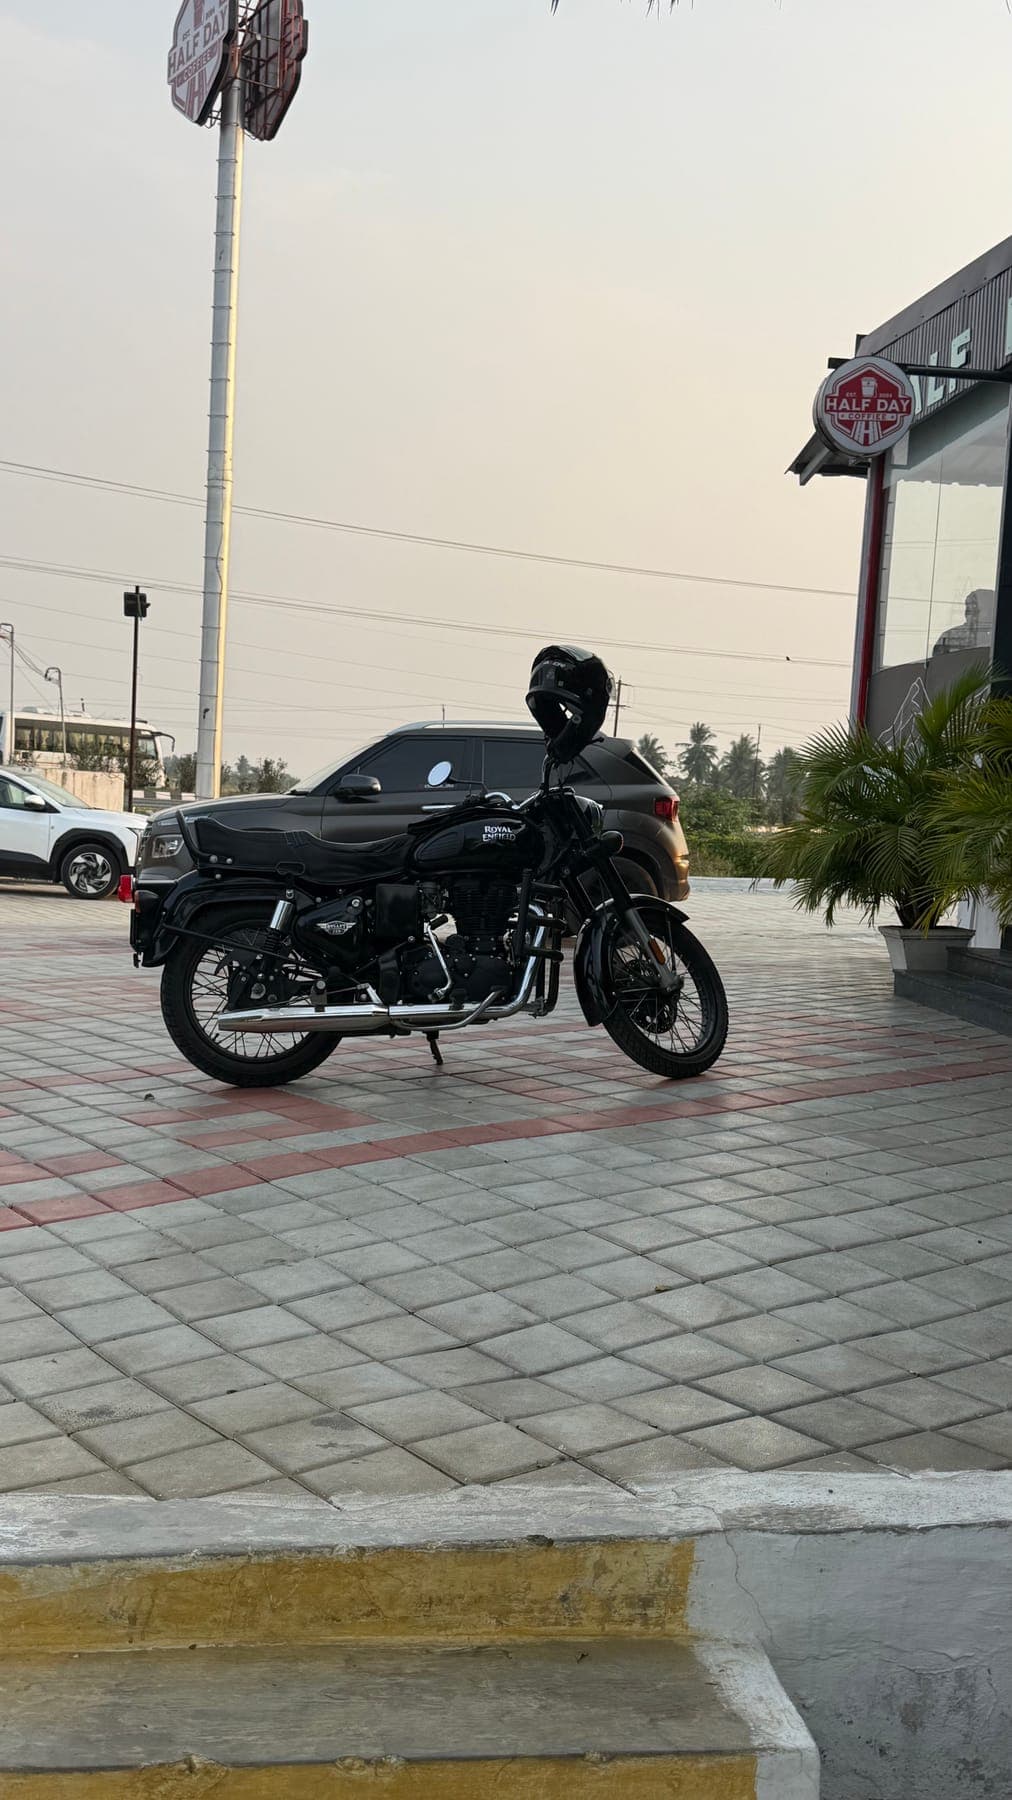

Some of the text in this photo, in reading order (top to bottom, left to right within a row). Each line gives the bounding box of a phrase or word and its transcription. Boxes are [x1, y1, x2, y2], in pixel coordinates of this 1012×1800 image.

[168, 8, 227, 78] HALF DAY
[183, 49, 212, 81] COFFEE
[826, 397, 911, 412] HALF DAY
[848, 413, 887, 421] COFFEE
[484, 825, 512, 833] ROYAL
[482, 833, 516, 842] ENFIELD
